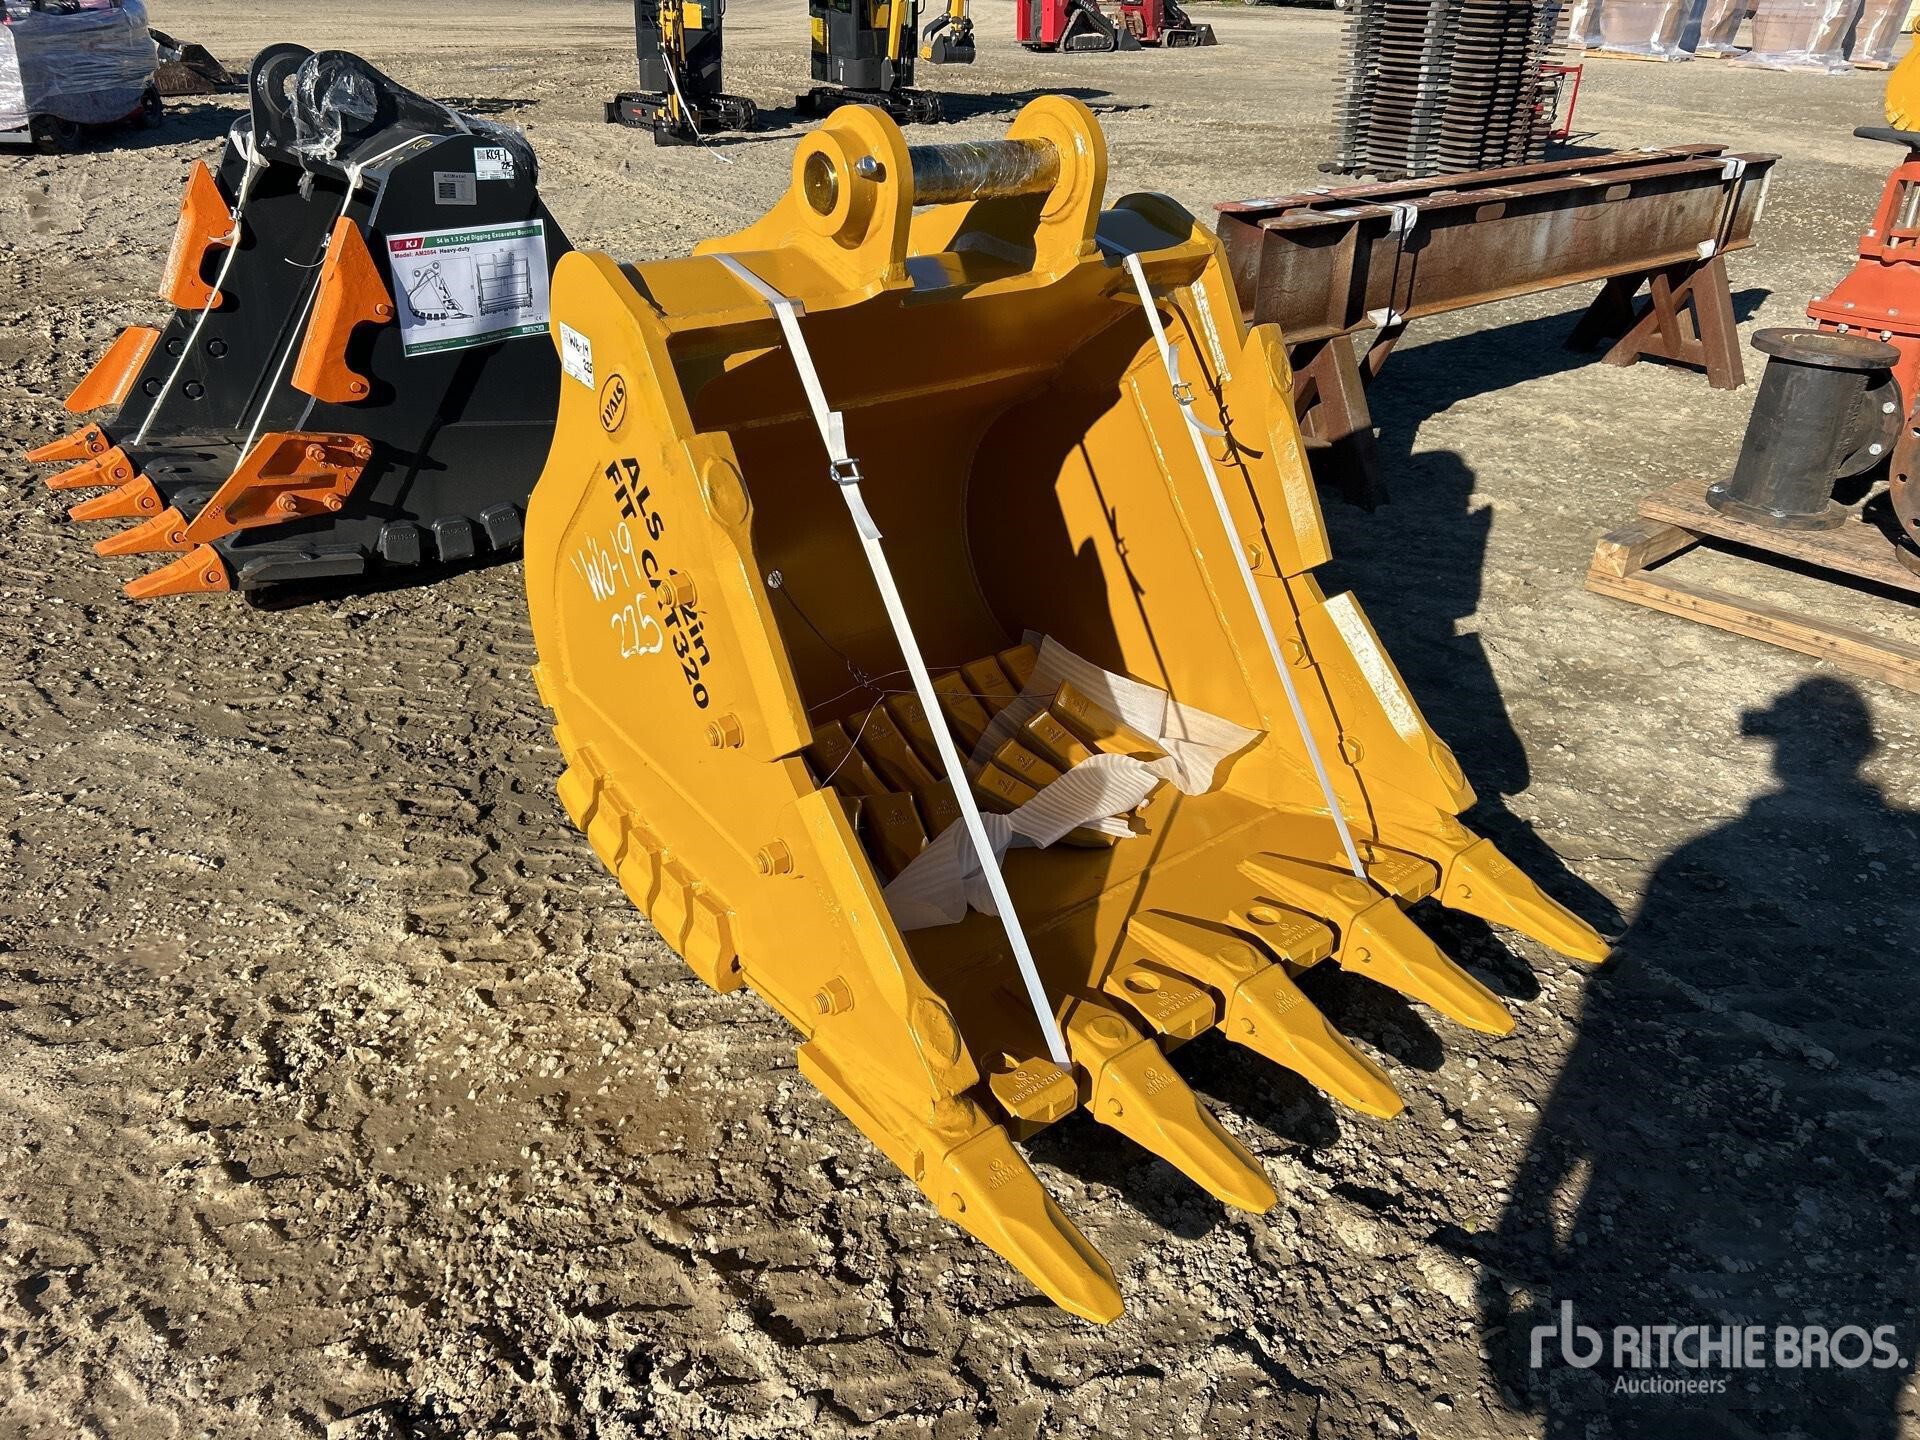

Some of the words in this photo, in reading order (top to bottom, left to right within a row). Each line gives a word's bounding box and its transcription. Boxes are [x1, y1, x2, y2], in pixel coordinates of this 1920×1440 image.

[406, 240, 418, 248] KJ
[471, 233, 491, 241] Digging
[492, 231, 517, 239] Excavator
[604, 460, 637, 520] FIT
[620, 457, 664, 541] ALS
[611, 592, 663, 659] 225
